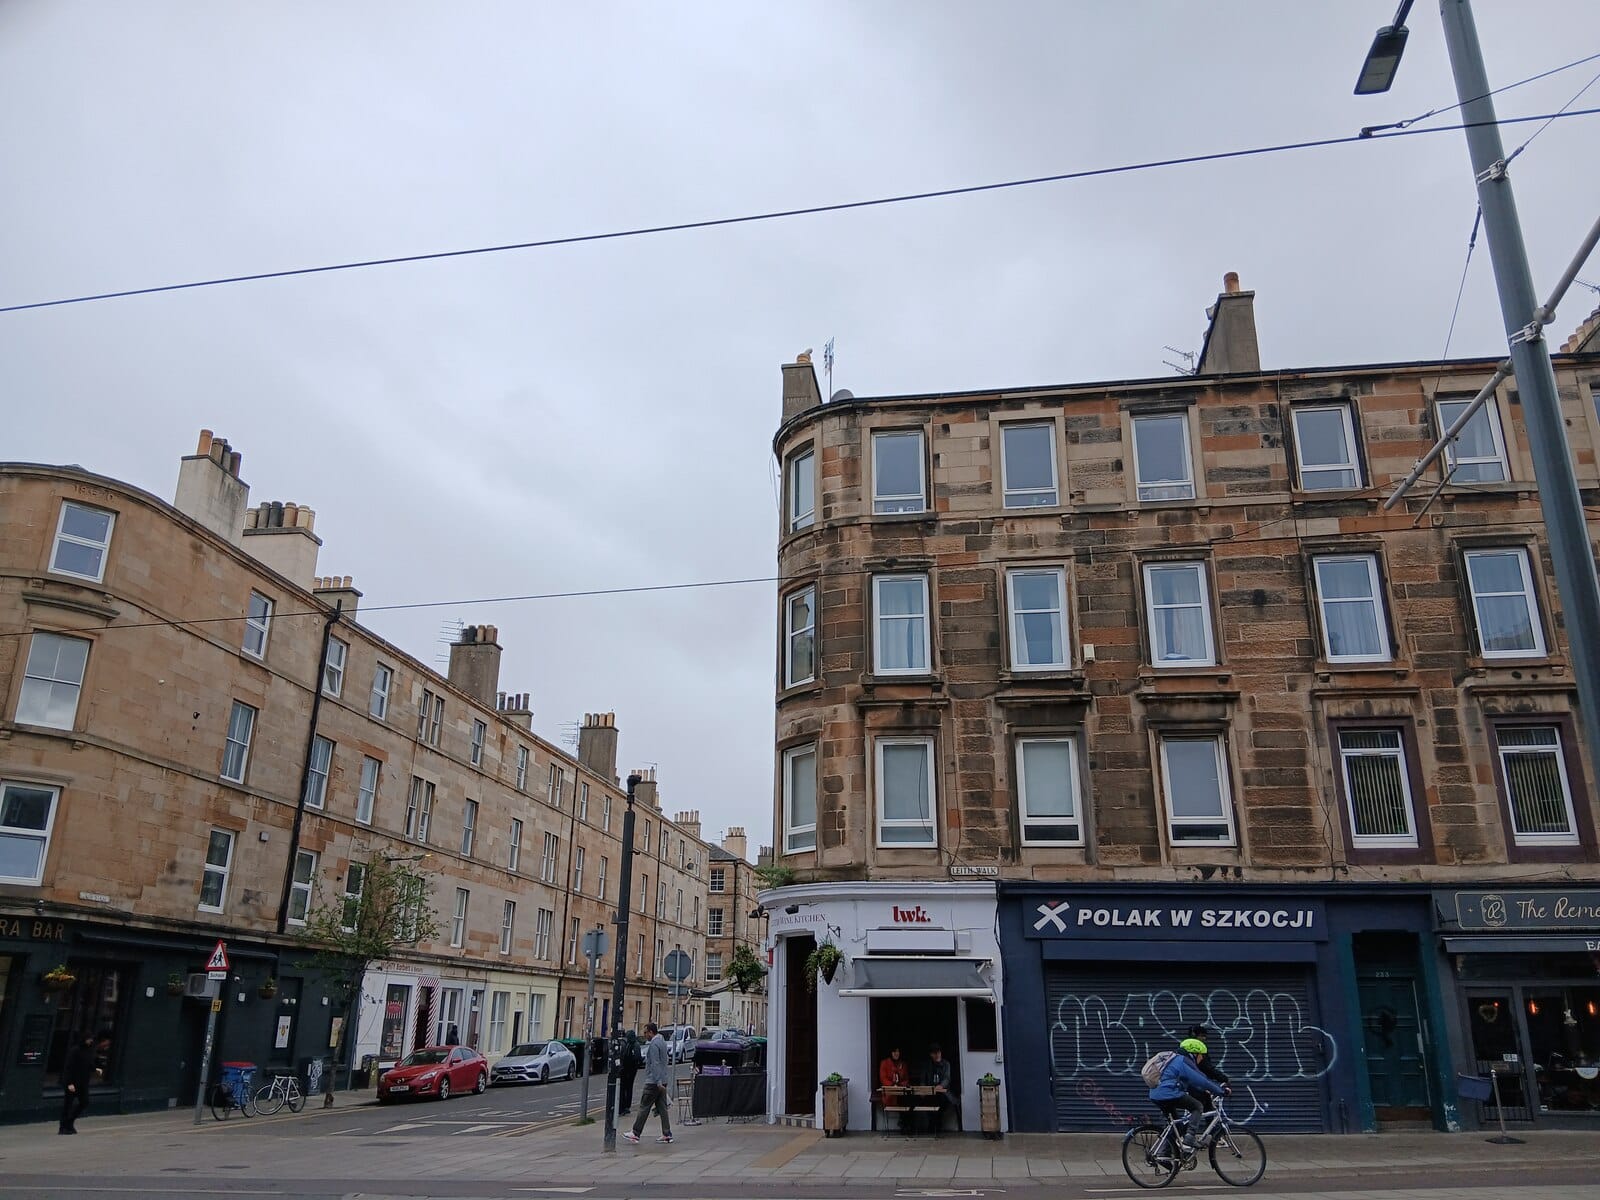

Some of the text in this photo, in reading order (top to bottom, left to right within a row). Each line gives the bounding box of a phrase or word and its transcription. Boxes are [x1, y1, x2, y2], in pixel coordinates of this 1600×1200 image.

[952, 867, 996, 875] LEITH WALK
[1516, 898, 1548, 919] The
[1077, 909, 1314, 928] POLAK W SZKOCJI
[32, 921, 65, 940] BAR
